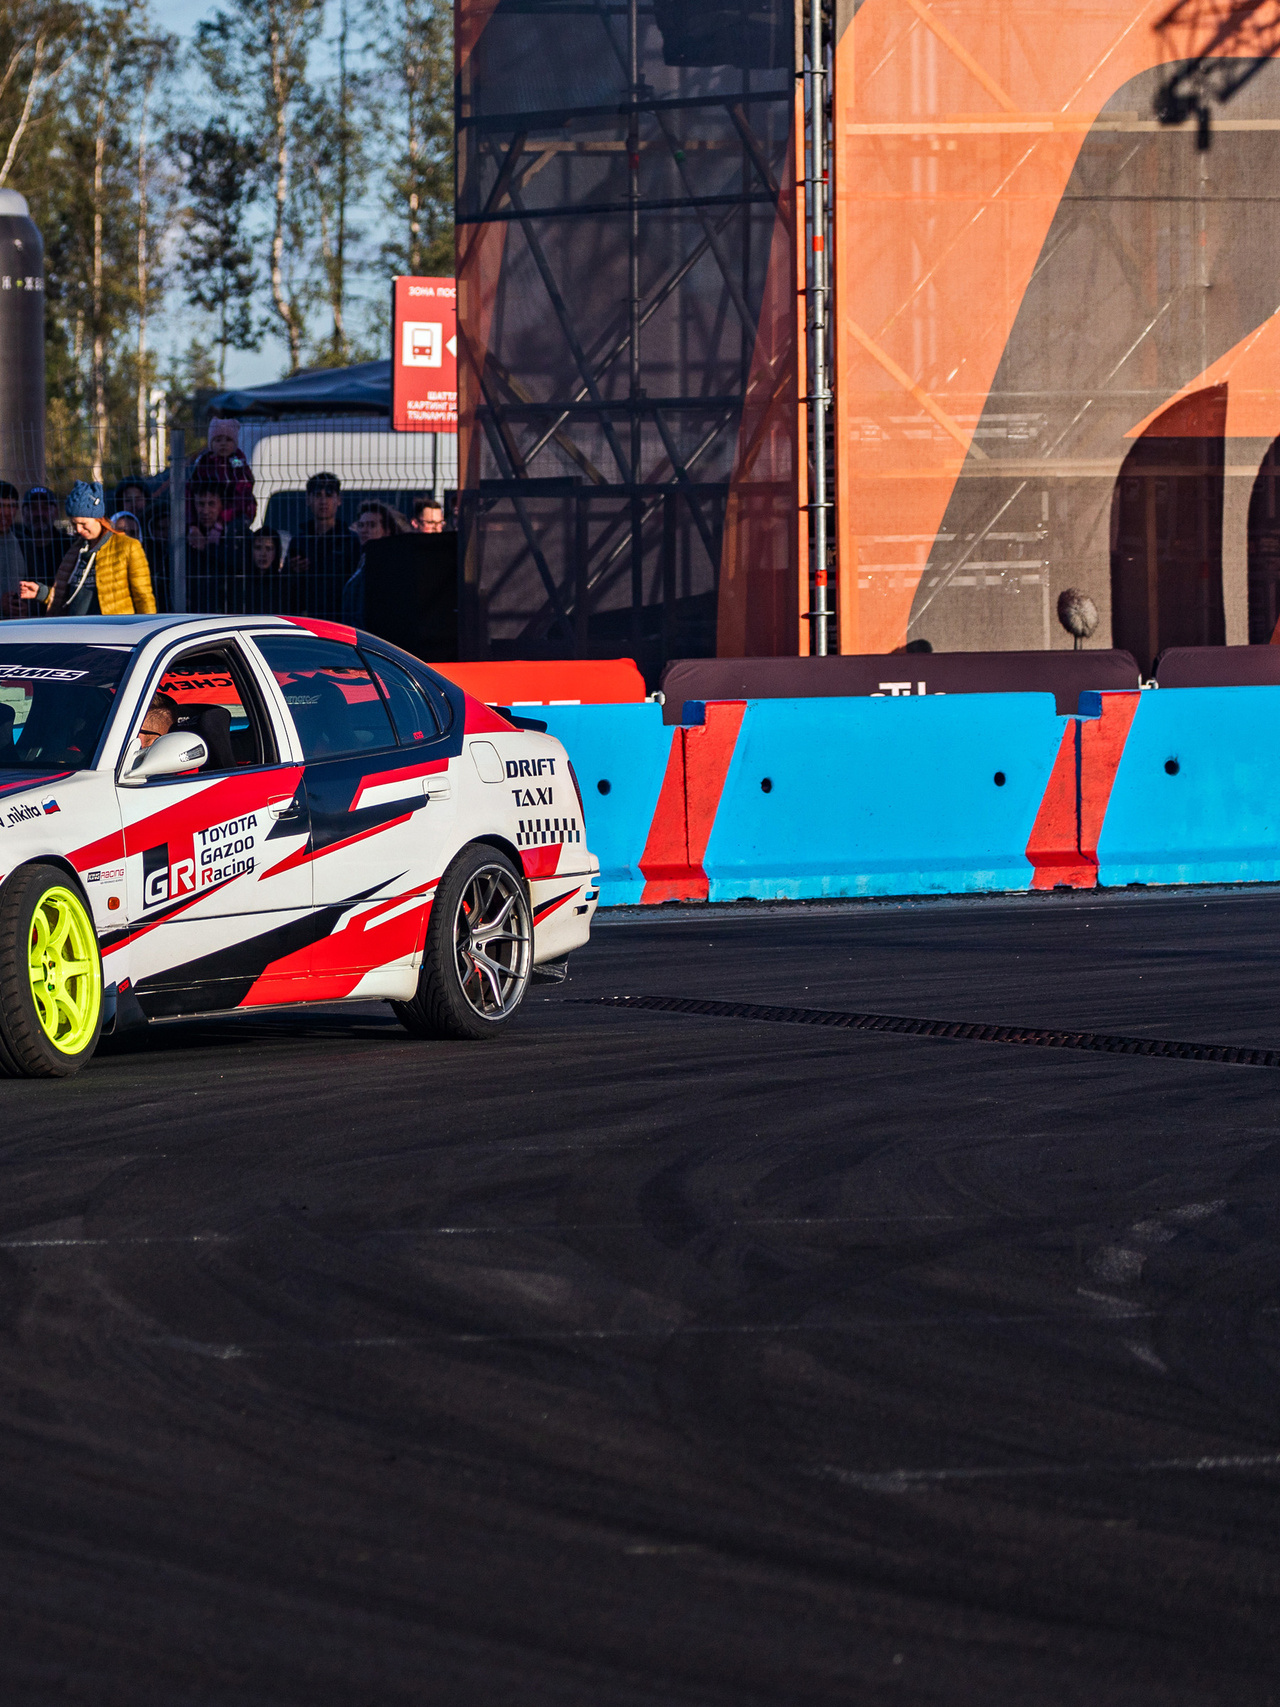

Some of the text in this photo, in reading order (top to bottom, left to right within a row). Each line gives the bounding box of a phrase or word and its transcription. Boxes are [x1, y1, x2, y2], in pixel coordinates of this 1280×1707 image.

[408, 286, 435, 297] ЗОНА
[407, 400, 448, 410] КАРТИНГ
[506, 758, 555, 778] DRIFT
[512, 787, 553, 807] TAXI
[198, 814, 258, 845] TOYOTA
[201, 835, 255, 866] GAZOO
[145, 857, 195, 905] GR
[201, 857, 255, 886] Racing
